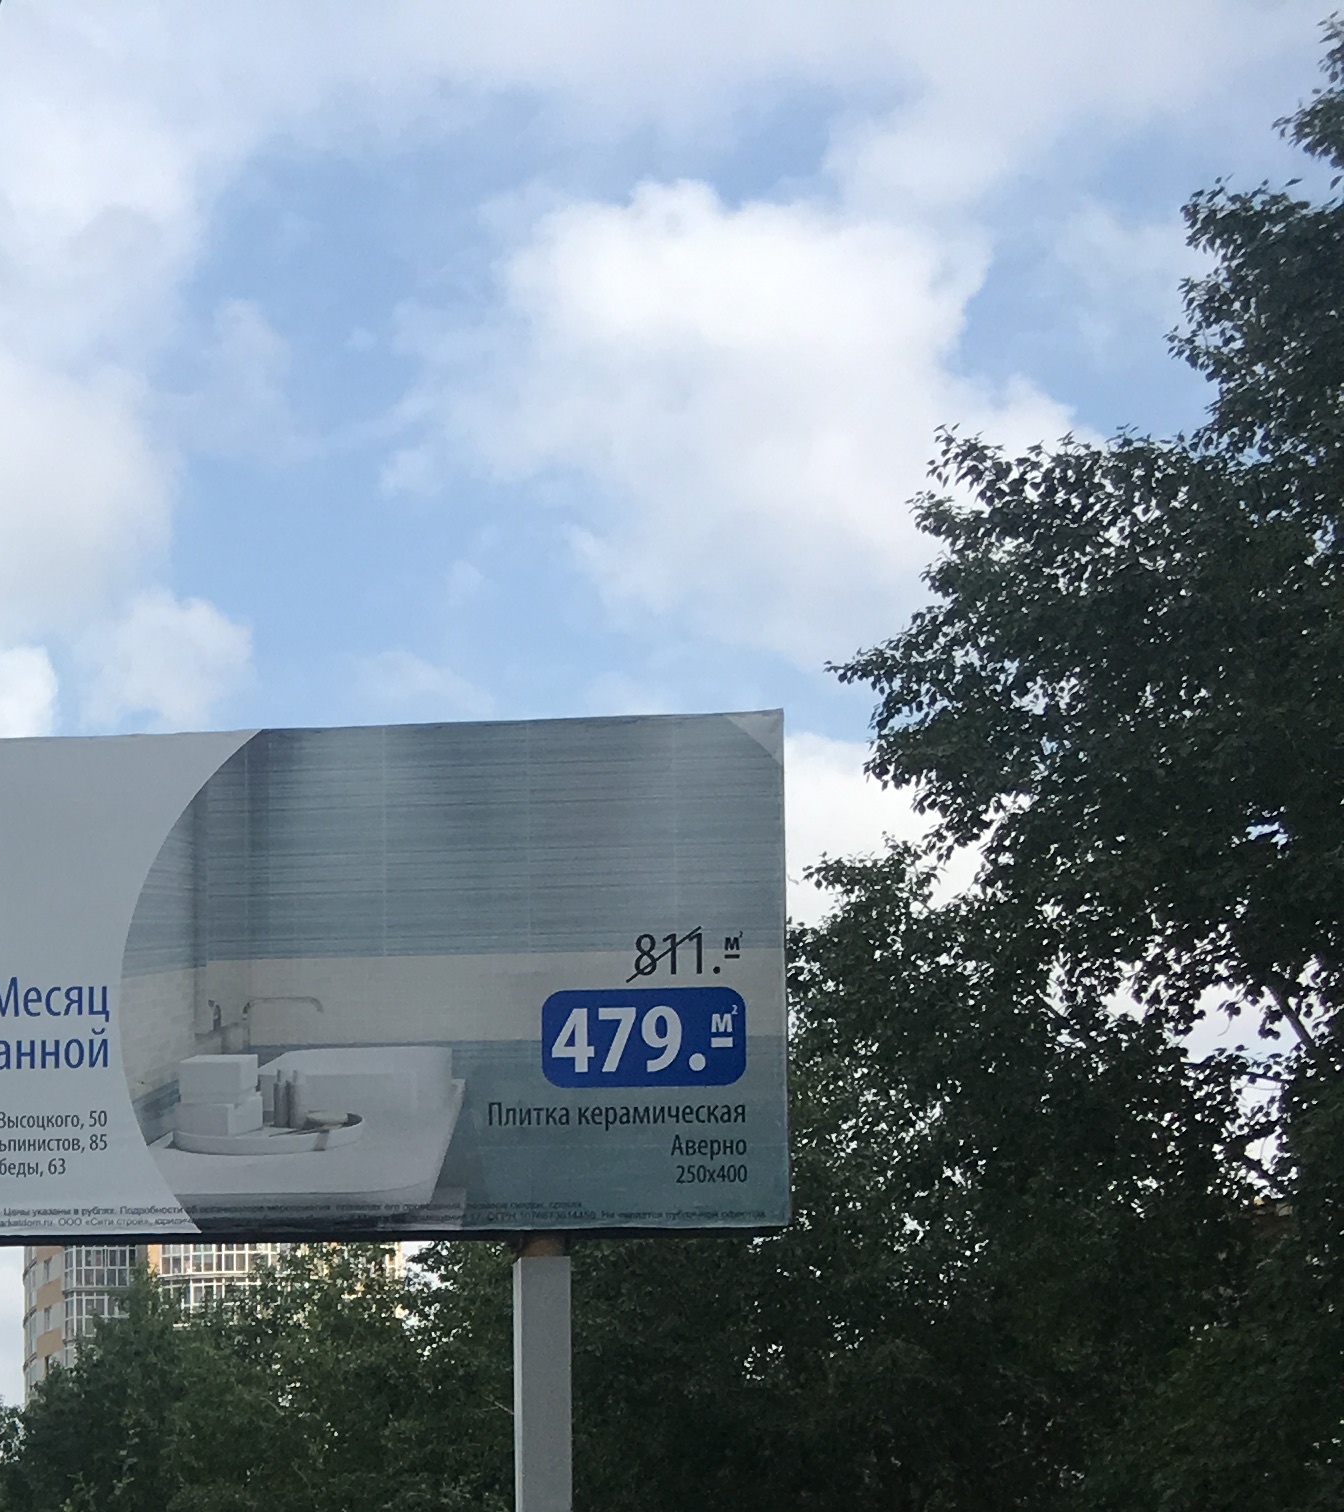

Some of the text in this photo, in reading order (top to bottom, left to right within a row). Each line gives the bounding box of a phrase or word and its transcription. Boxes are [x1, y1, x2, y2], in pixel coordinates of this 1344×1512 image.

[88, 1111, 108, 1128] 50
[487, 1102, 746, 1132] Плитка керамическая
[89, 1134, 108, 1151] 85
[670, 1134, 747, 1161] Аверно
[47, 1158, 66, 1175] 63
